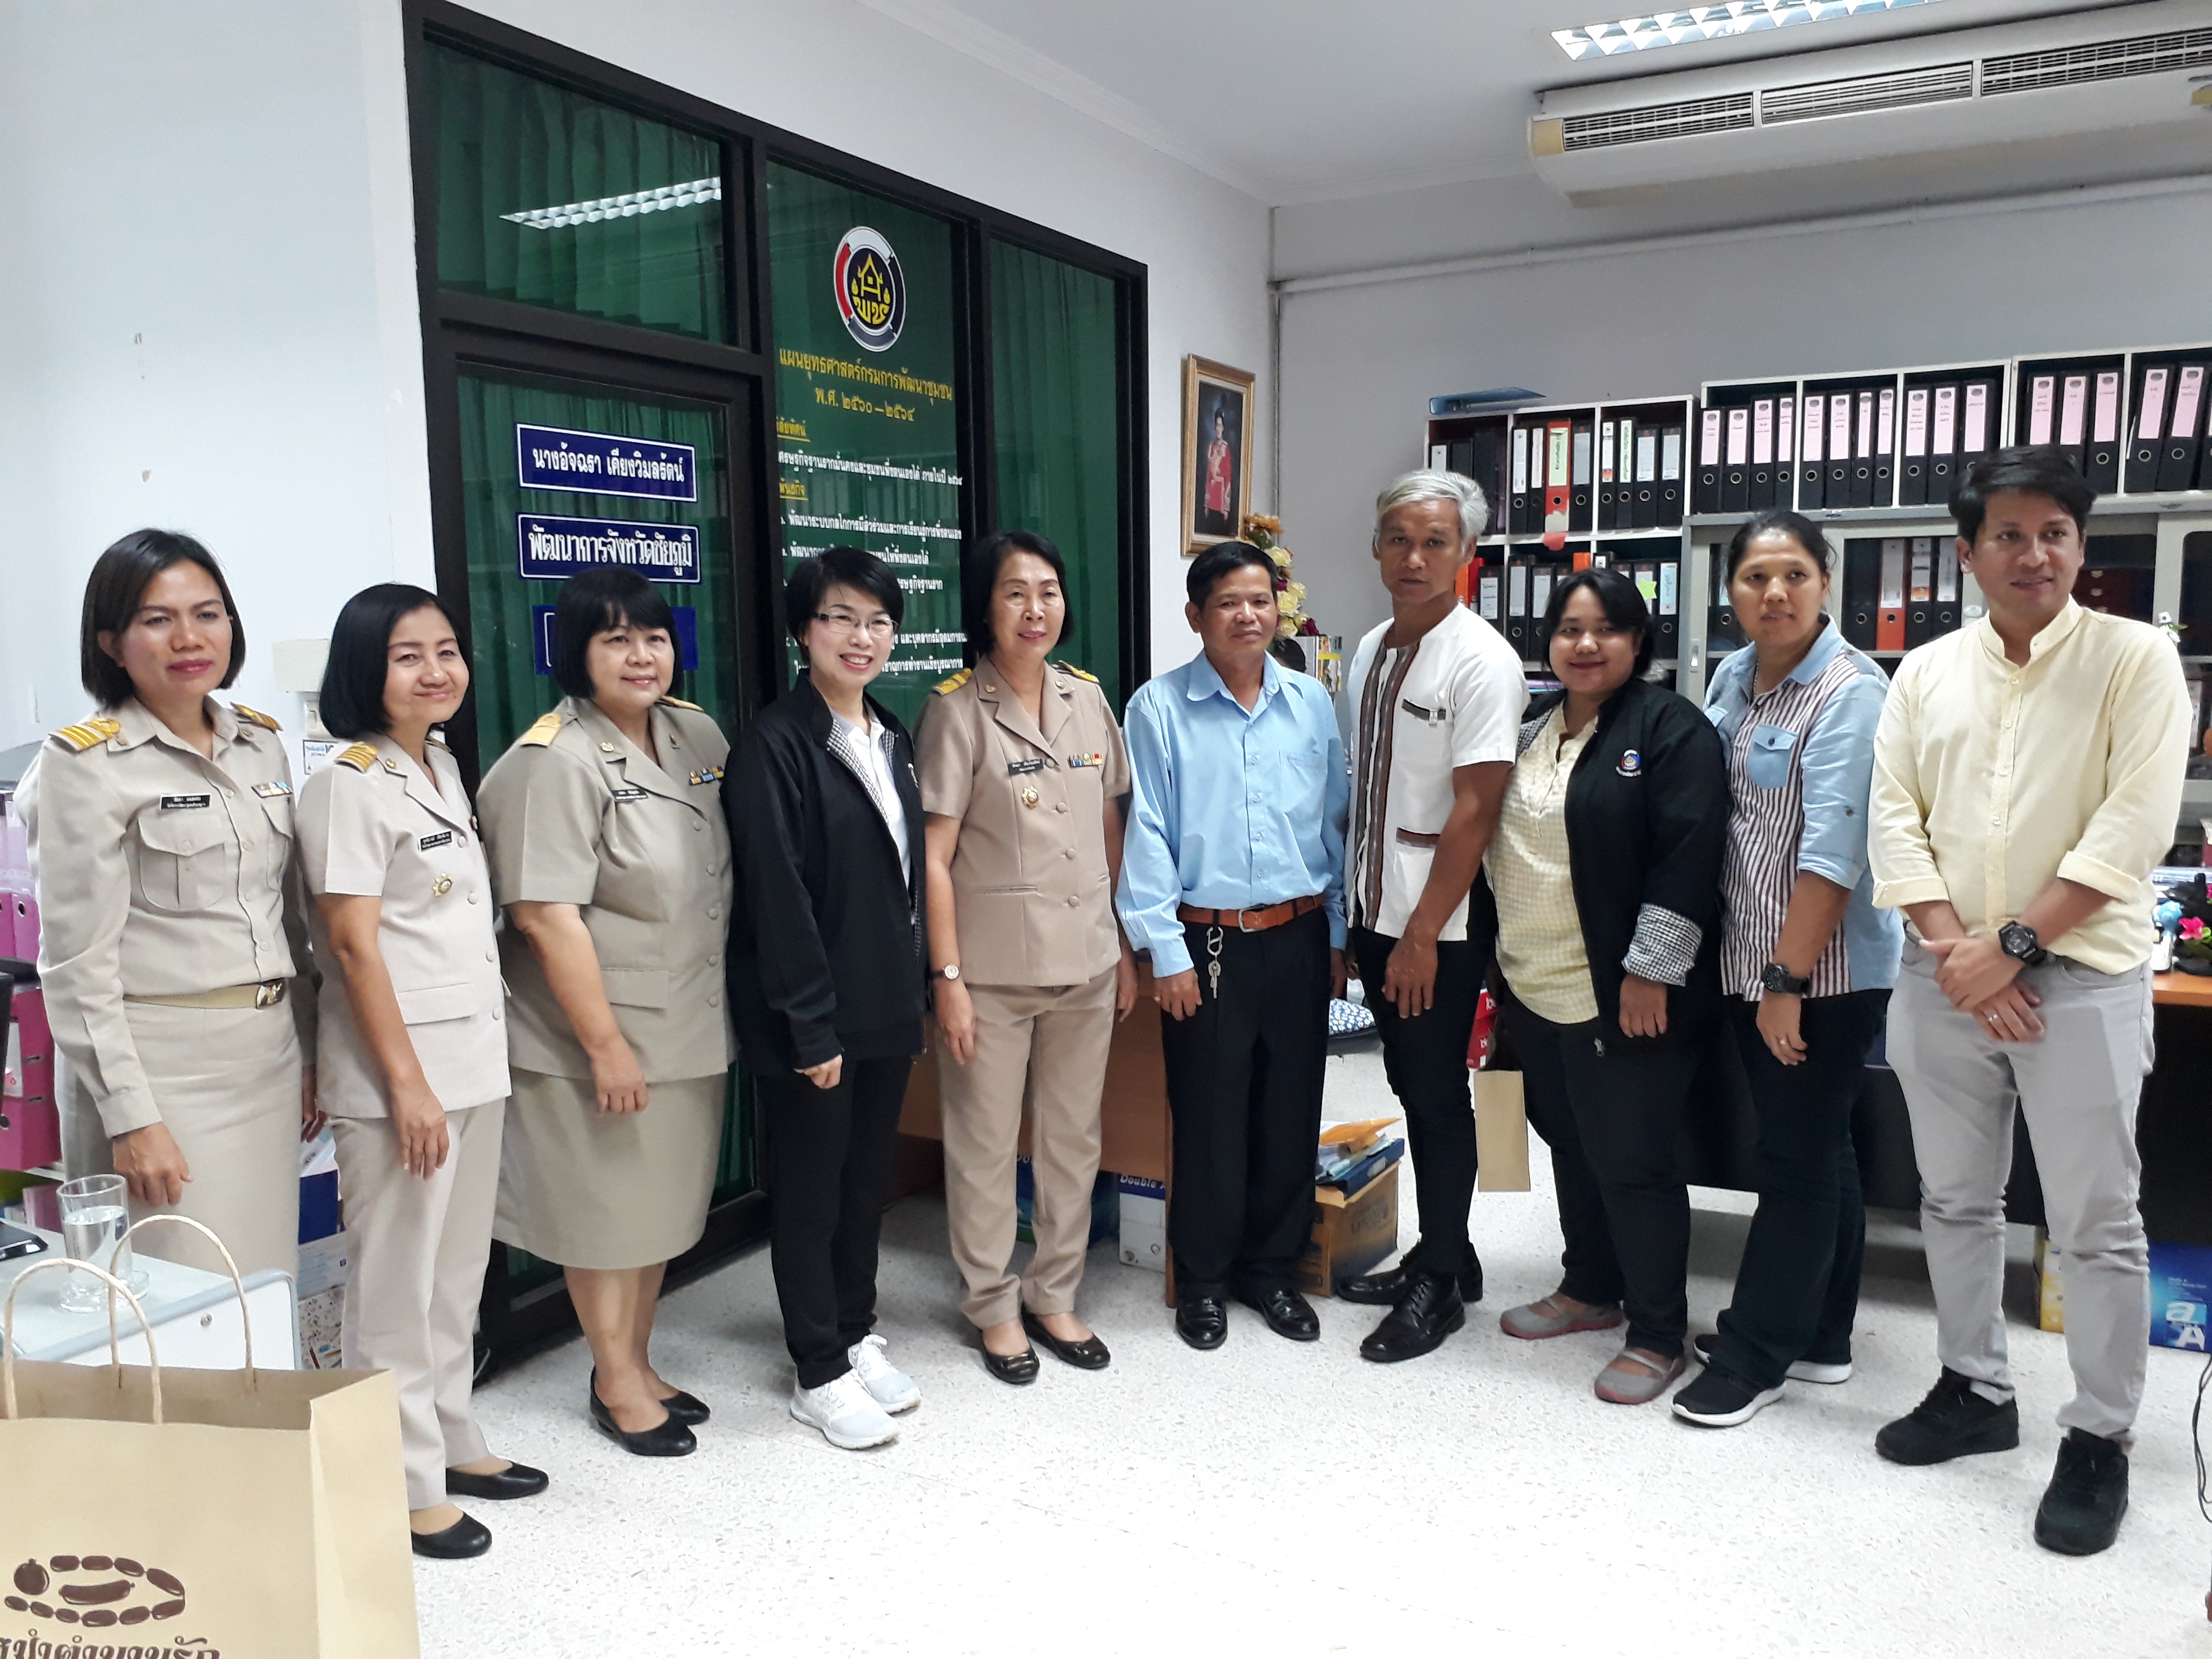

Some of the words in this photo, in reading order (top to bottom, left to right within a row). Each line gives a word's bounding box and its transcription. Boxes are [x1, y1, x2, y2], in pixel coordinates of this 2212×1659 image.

[815, 387, 839, 407] พ.ศ.
[532, 441, 602, 474] นางอัจฉรา
[528, 524, 693, 576] พัฒนาการจังหวัดชัยภูมิ
